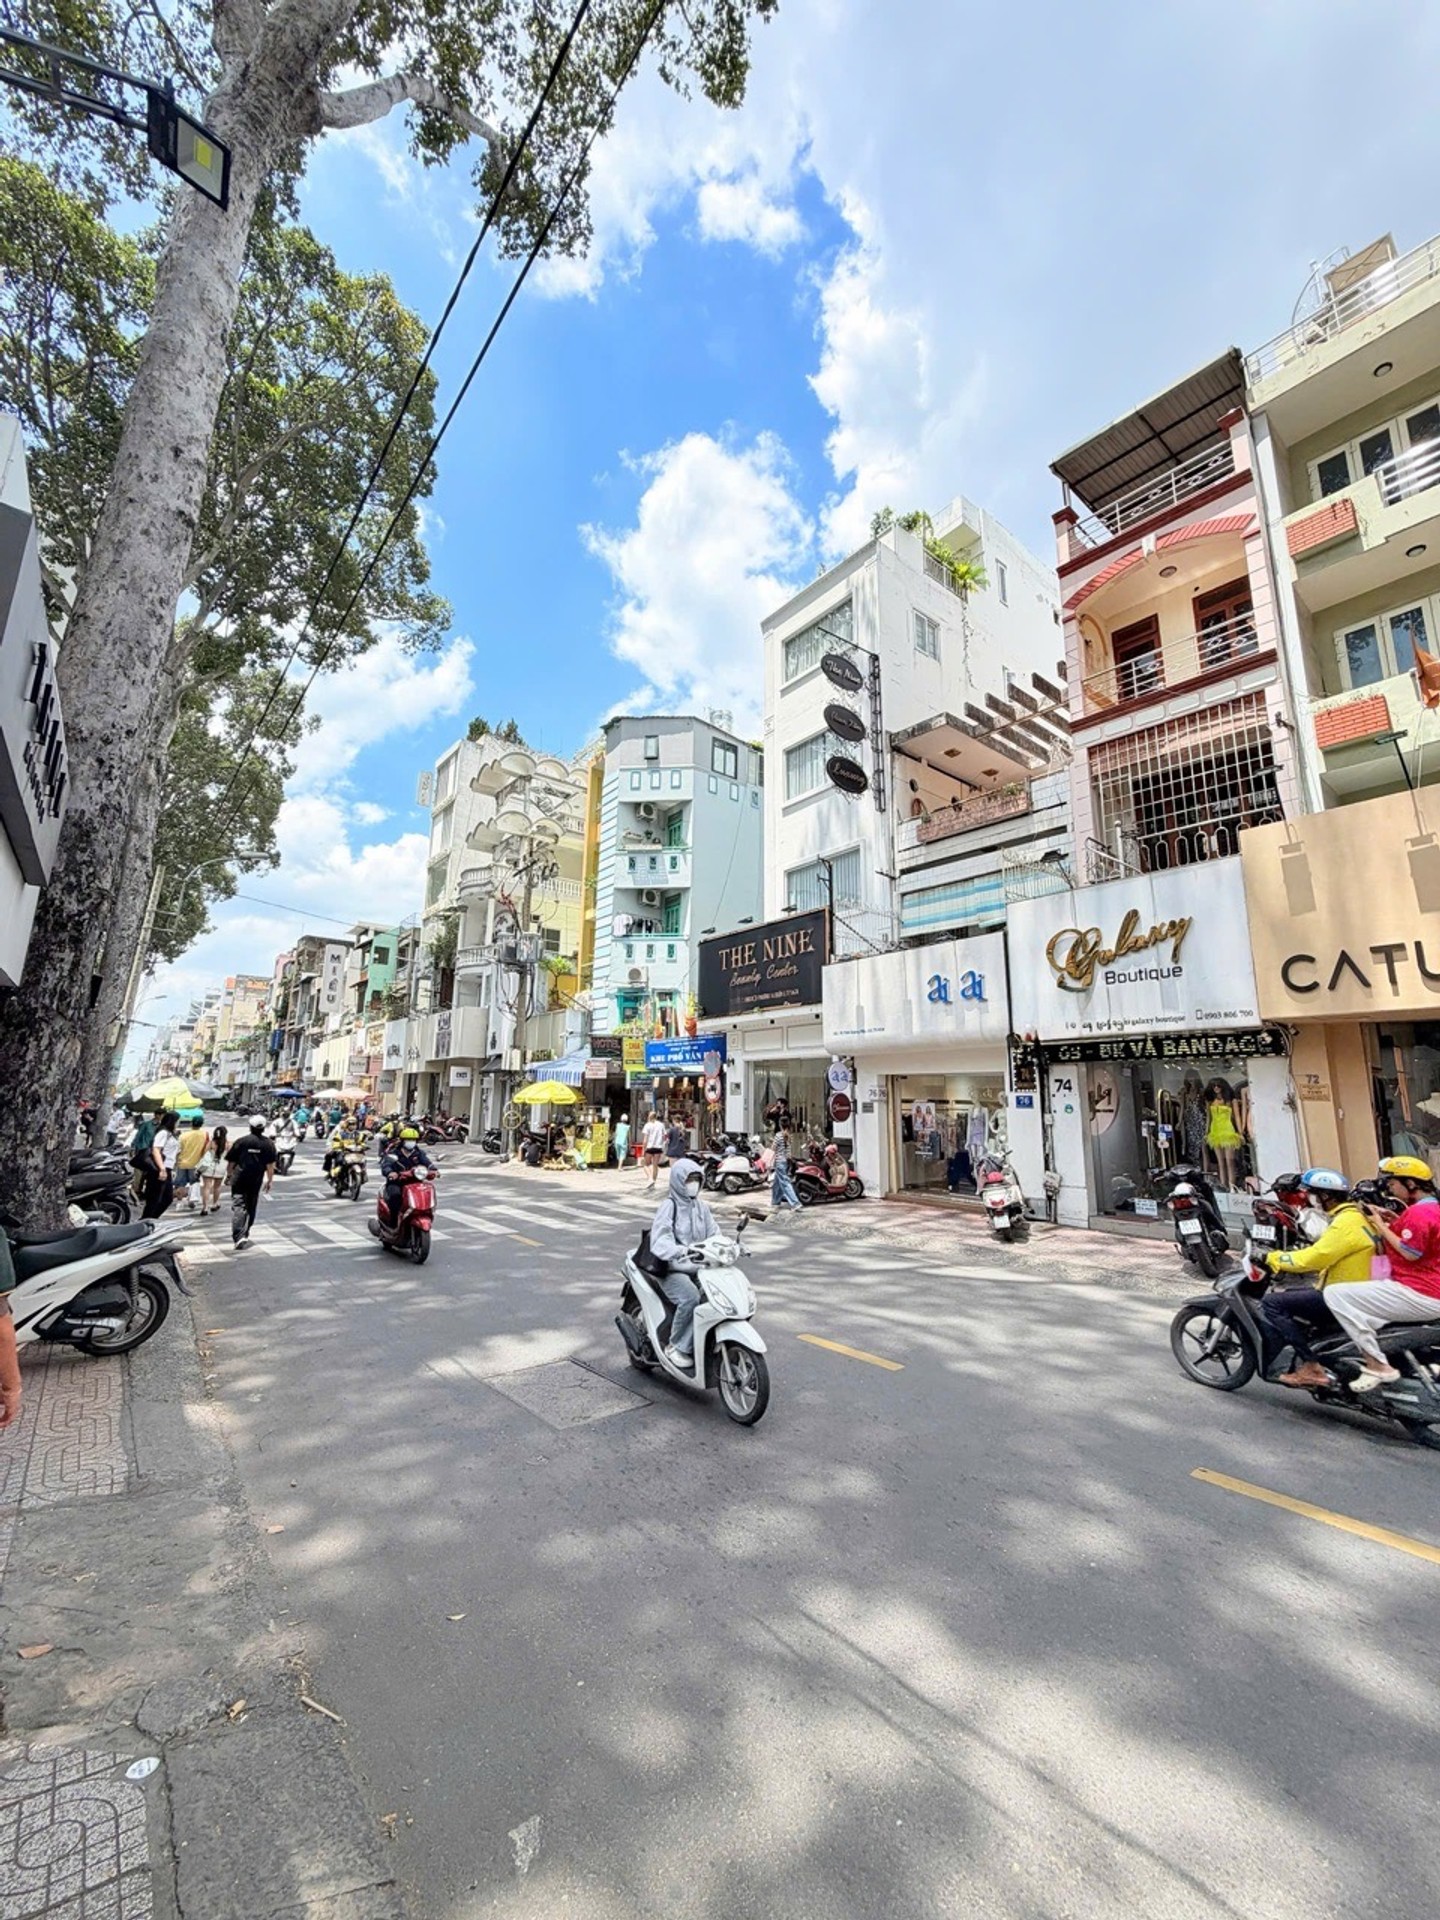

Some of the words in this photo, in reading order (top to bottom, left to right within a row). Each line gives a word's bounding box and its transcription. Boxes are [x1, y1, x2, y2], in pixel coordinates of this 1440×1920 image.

[718, 942, 756, 971] THE
[762, 927, 816, 961] NINE
[1046, 908, 1193, 992] Galaxy
[766, 962, 800, 979] Center
[1104, 965, 1183, 986] Boutique
[1054, 1079, 1073, 1092] 74
[1305, 1073, 1320, 1084] 72
[1020, 1096, 1030, 1105] 76
